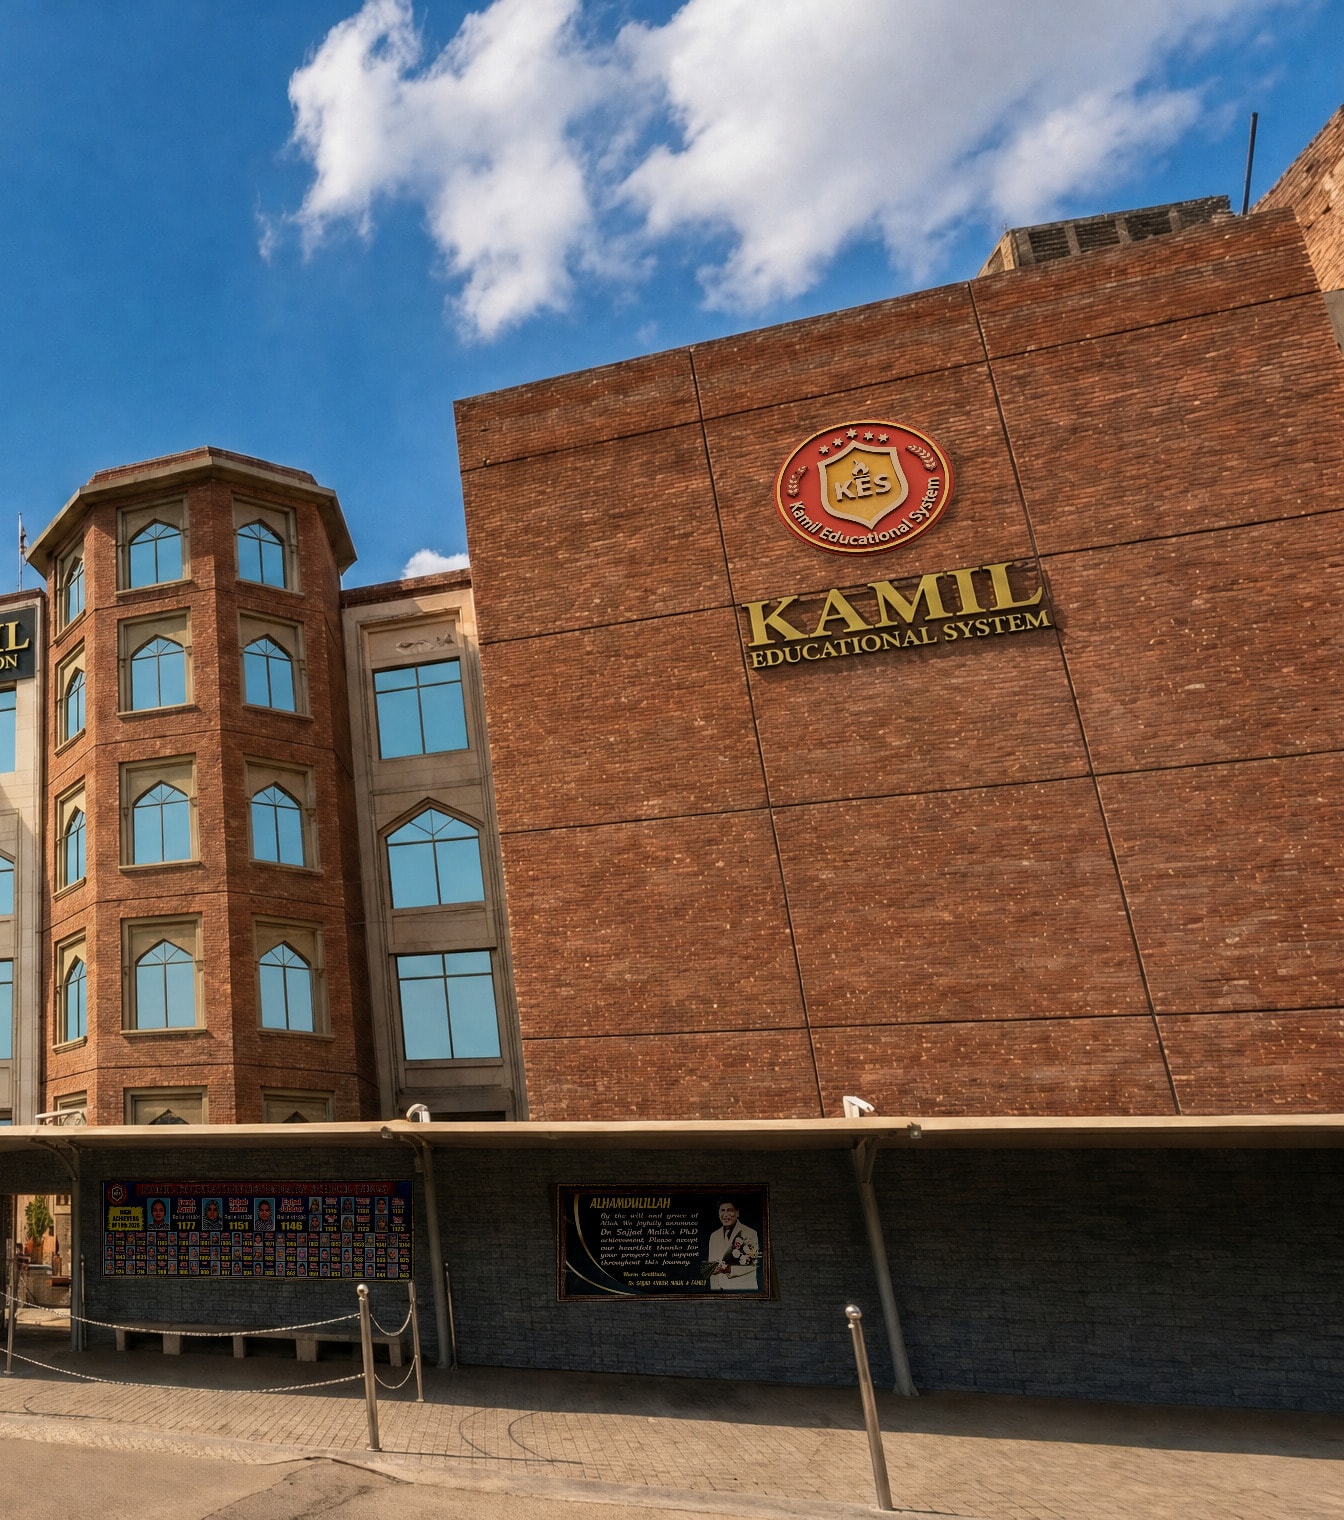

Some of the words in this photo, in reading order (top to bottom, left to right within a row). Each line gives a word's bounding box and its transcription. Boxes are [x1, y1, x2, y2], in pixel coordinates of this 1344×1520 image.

[834, 474, 892, 501] KES
[789, 499, 822, 535] Kamil
[818, 518, 913, 546] Educational
[909, 476, 940, 523] System
[742, 561, 1043, 648] KAMIL
[750, 626, 938, 669] EDUCATIONAL
[943, 609, 1052, 642] SYSTEM
[589, 1197, 671, 1209] ALHAMDULILLAH
[600, 1212, 610, 1220] By
[176, 1222, 196, 1230] 1177
[228, 1222, 248, 1230] 1151
[280, 1222, 302, 1230] 1146
[616, 1228, 642, 1236] Sajjad
[647, 1228, 675, 1236] Malik's
